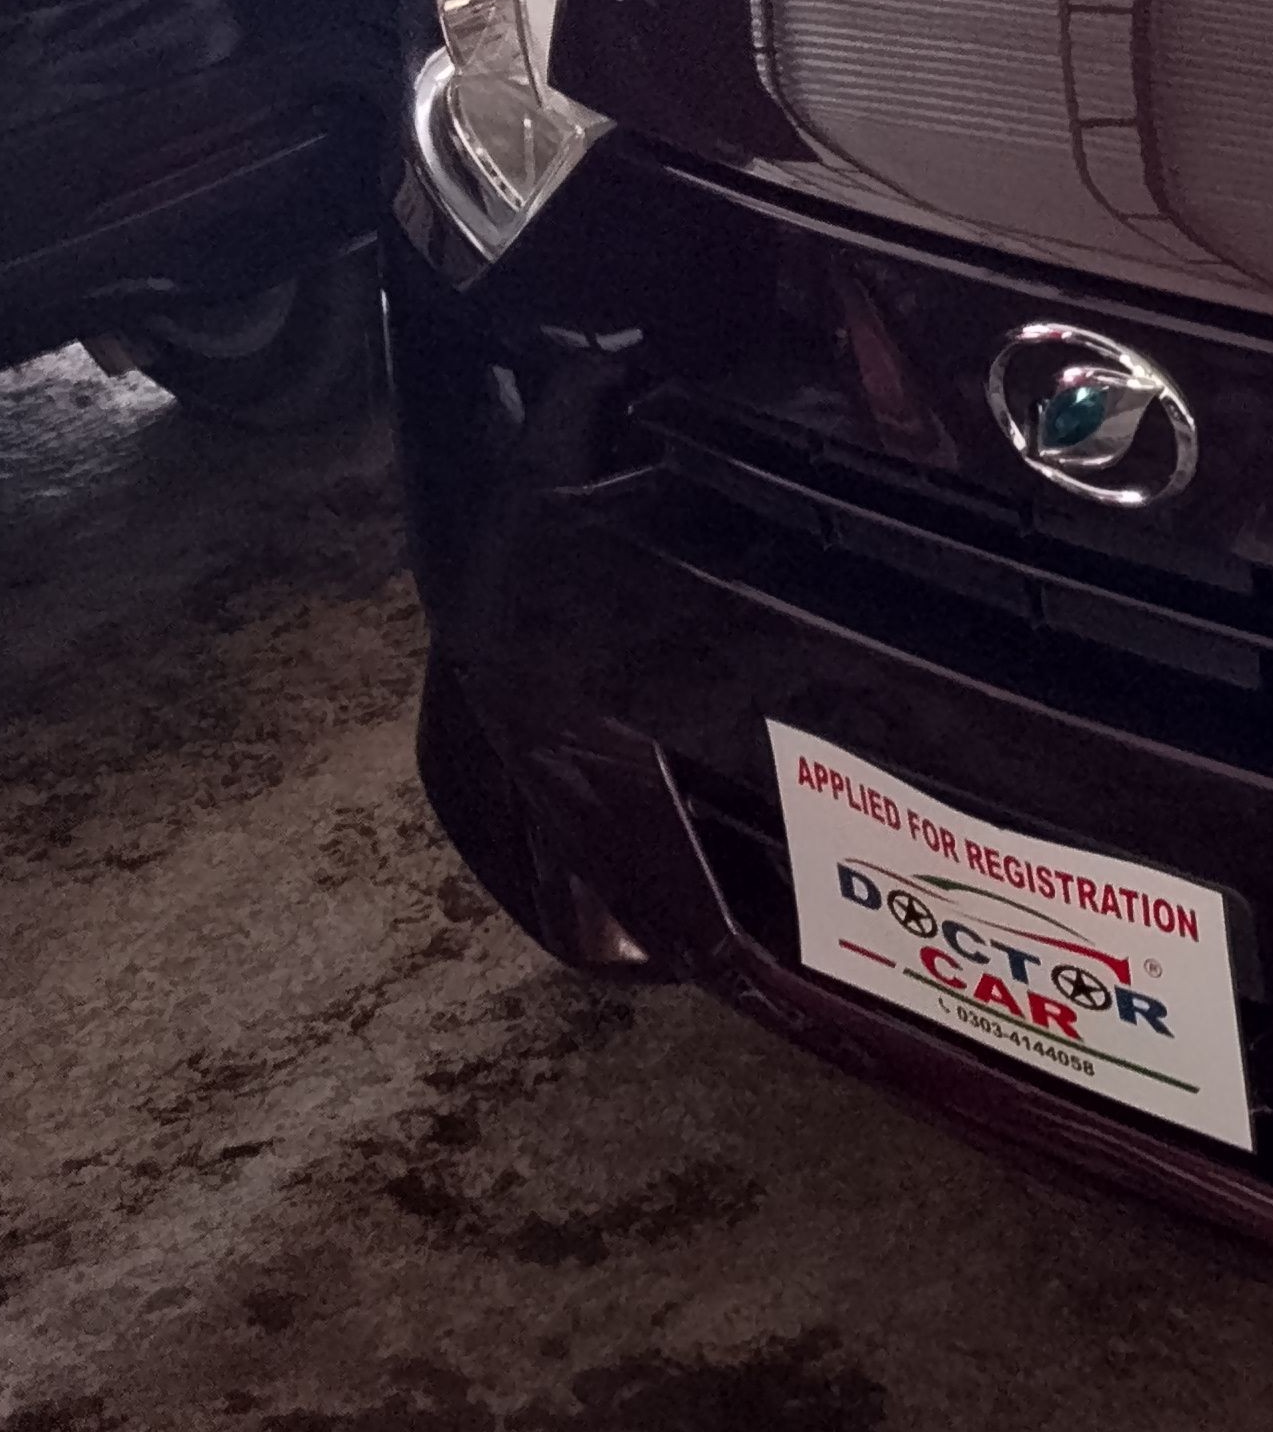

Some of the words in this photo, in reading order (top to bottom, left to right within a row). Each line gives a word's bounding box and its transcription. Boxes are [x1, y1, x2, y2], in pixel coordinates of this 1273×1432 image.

[797, 755, 902, 832] APPLIED
[907, 808, 960, 863] FOR
[965, 838, 1200, 943] REGISTRATION
[836, 861, 1176, 1040] DOCTOR
[918, 946, 1085, 1042] CAR
[956, 1006, 1096, 1078] 0303-4144058
